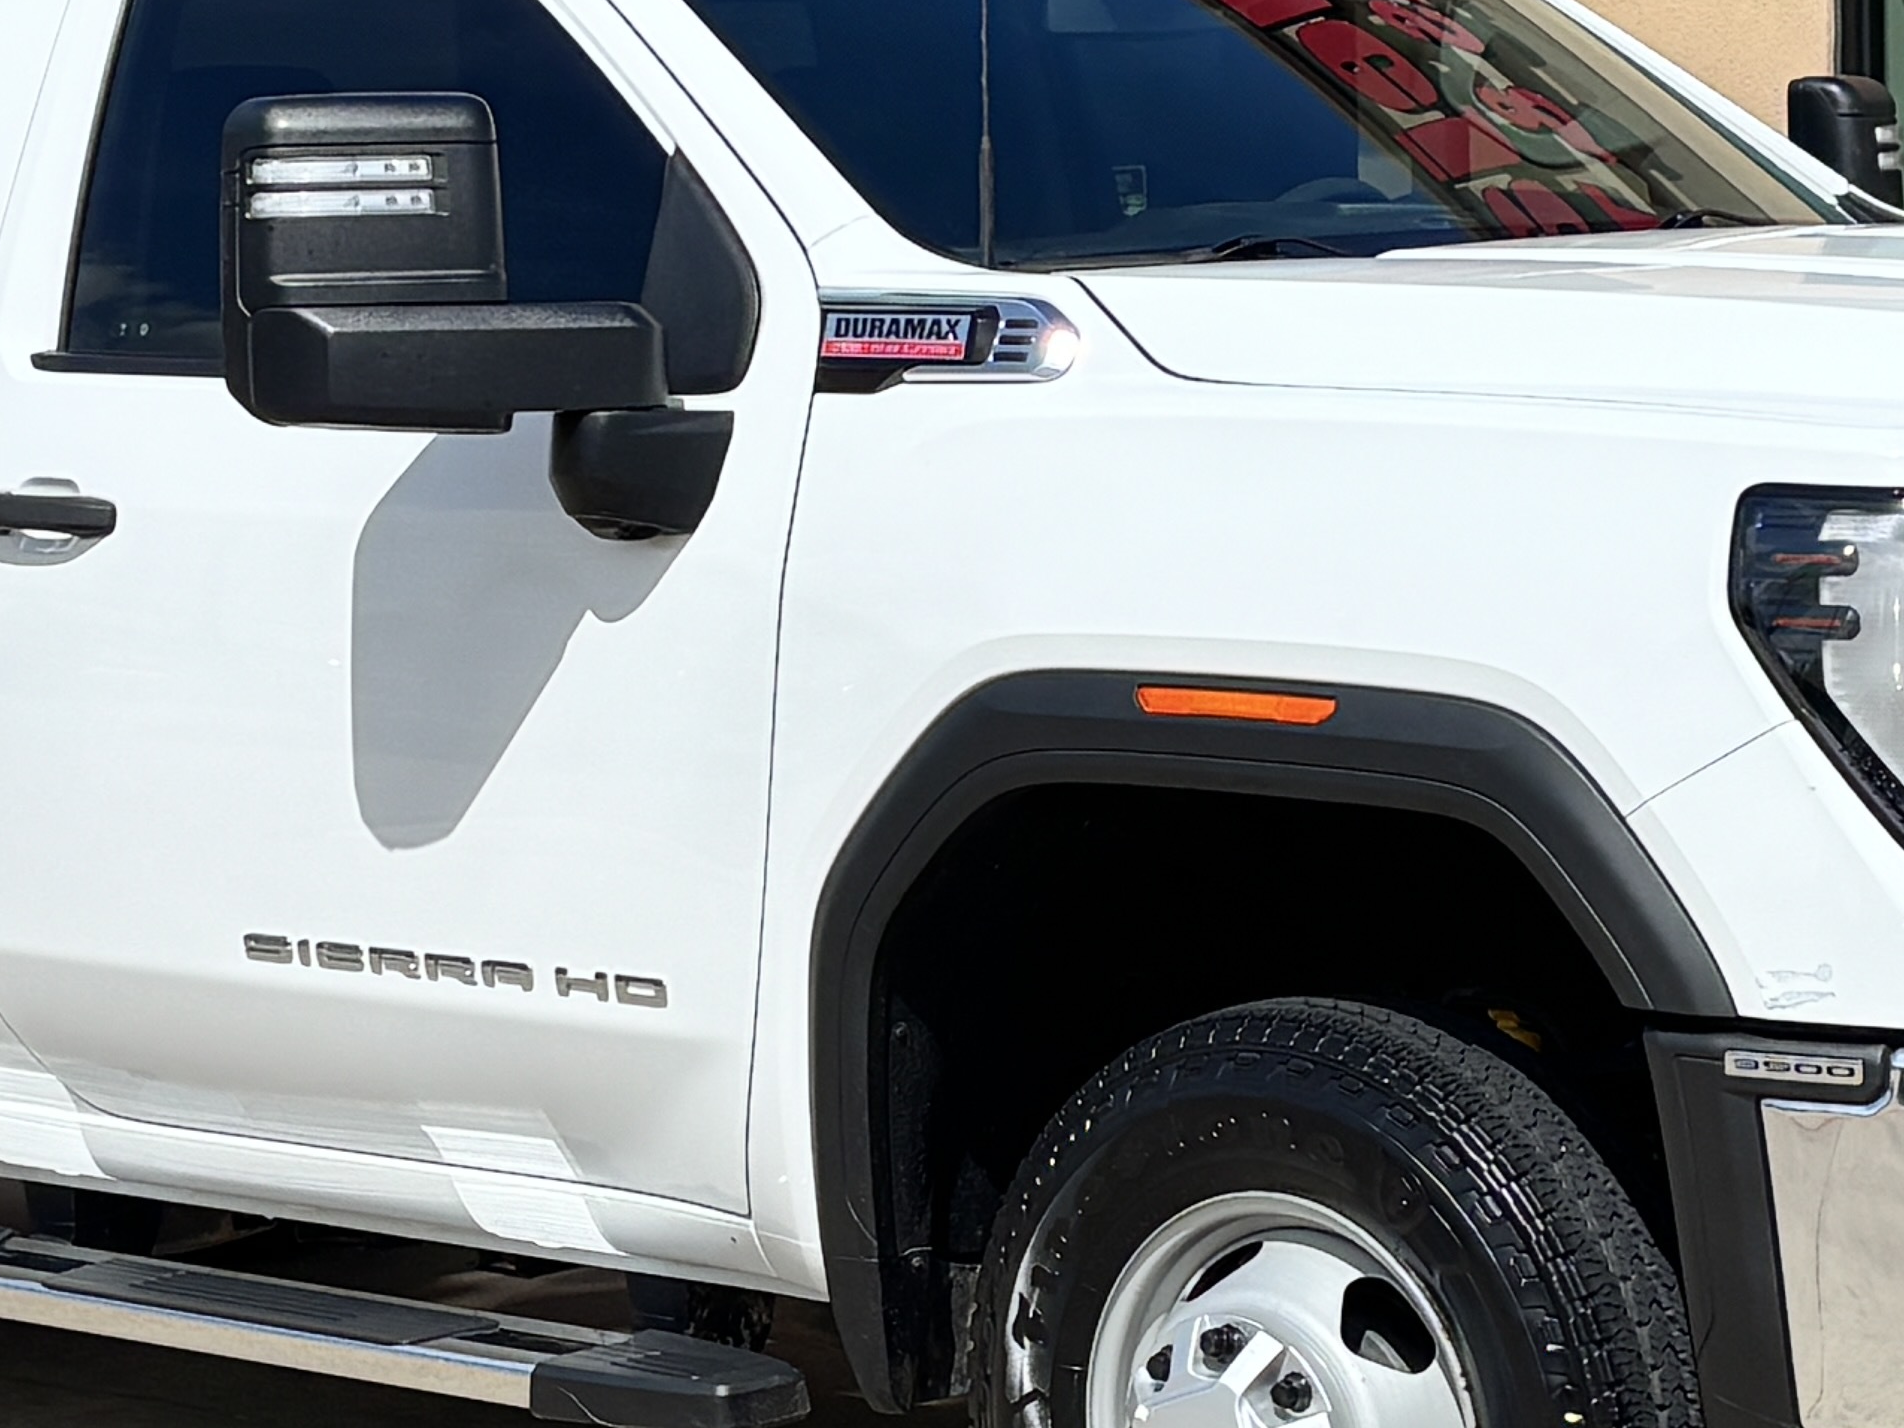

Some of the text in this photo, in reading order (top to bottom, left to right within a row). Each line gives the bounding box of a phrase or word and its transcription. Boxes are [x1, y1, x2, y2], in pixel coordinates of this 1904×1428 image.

[834, 317, 961, 341] DURAMAX
[243, 933, 668, 1009] SIERRA HD
